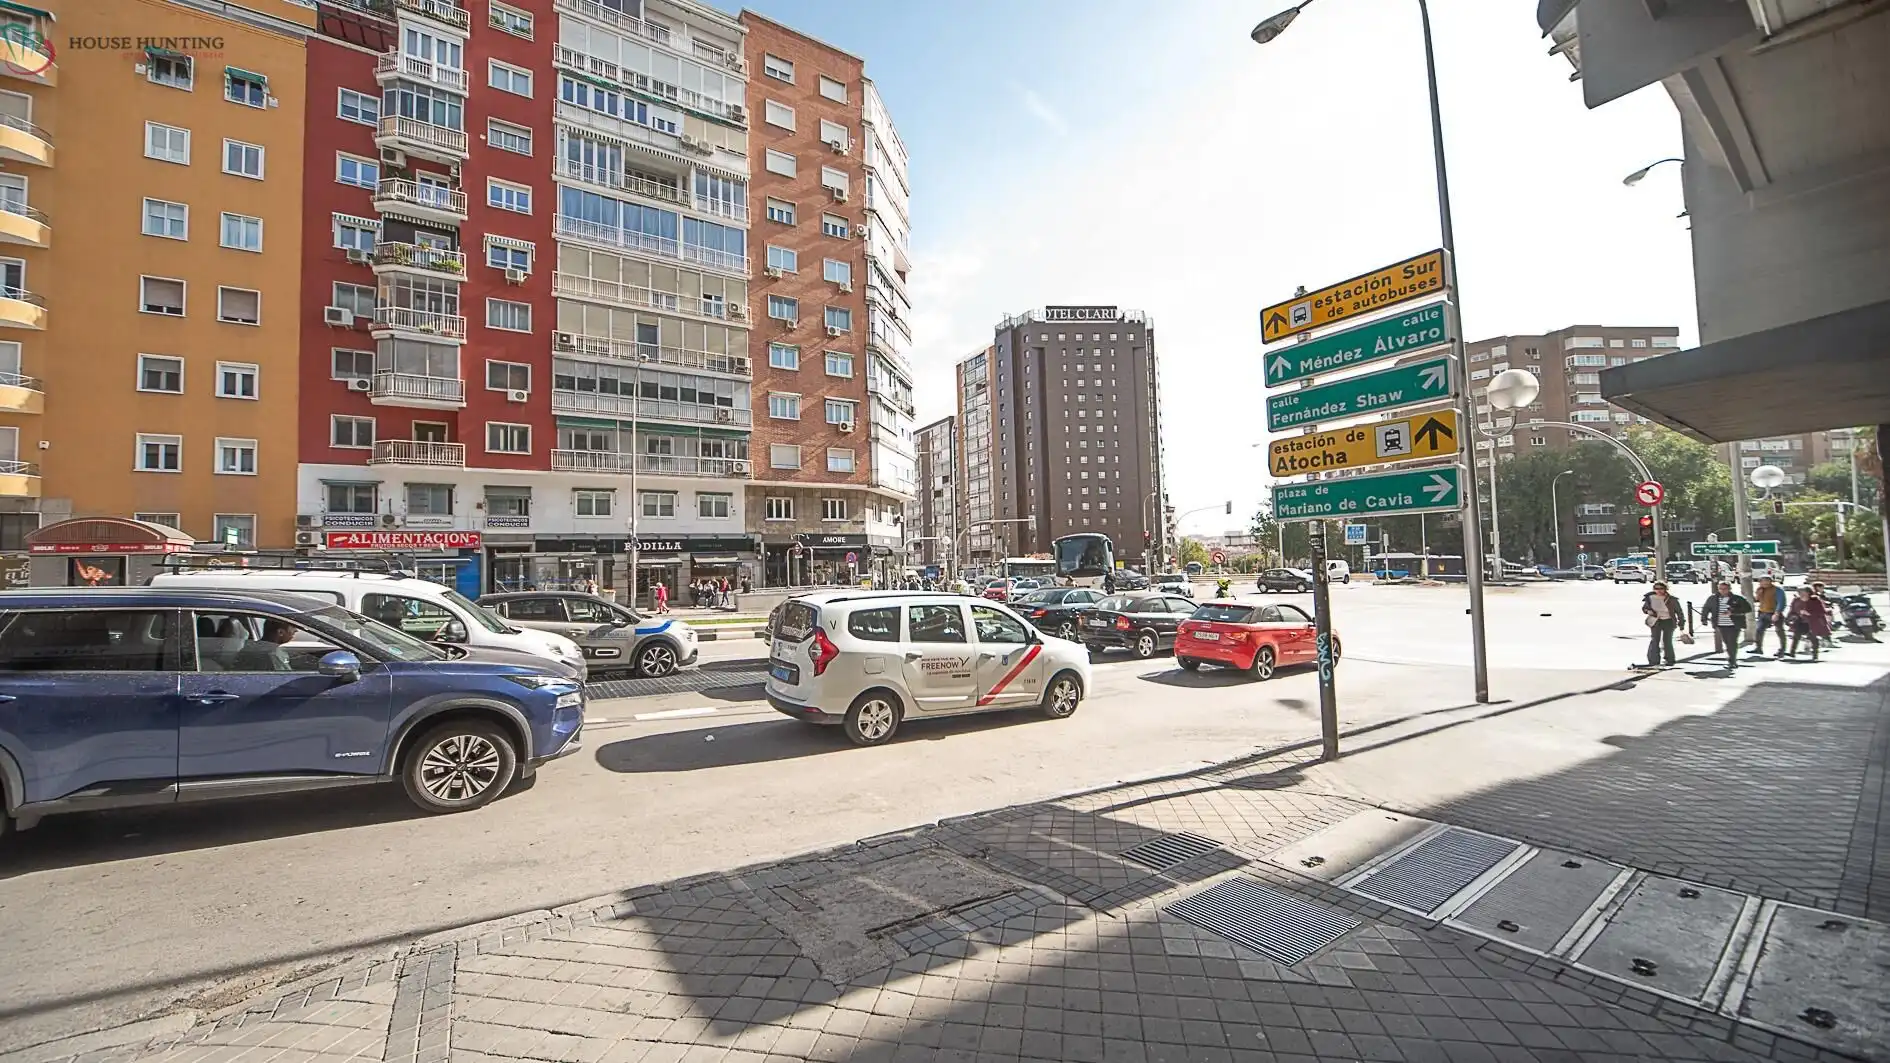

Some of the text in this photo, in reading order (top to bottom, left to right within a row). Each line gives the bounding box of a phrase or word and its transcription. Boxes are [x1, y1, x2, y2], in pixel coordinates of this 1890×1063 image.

[1314, 259, 1437, 309] estación Sur
[1327, 275, 1438, 318] de autobuses
[1402, 309, 1440, 328] calle
[1299, 326, 1441, 373] Méndez Álvaro
[1271, 396, 1300, 409] calle
[1272, 389, 1403, 425] Fernández Shaw
[1274, 430, 1365, 454] estación de
[1275, 450, 1348, 473] Atocha
[1277, 485, 1329, 500] plaza de
[1278, 493, 1413, 517] Mariano de Cavia
[347, 533, 470, 544] ALIMENTACION
[921, 661, 960, 671] FREENOW
